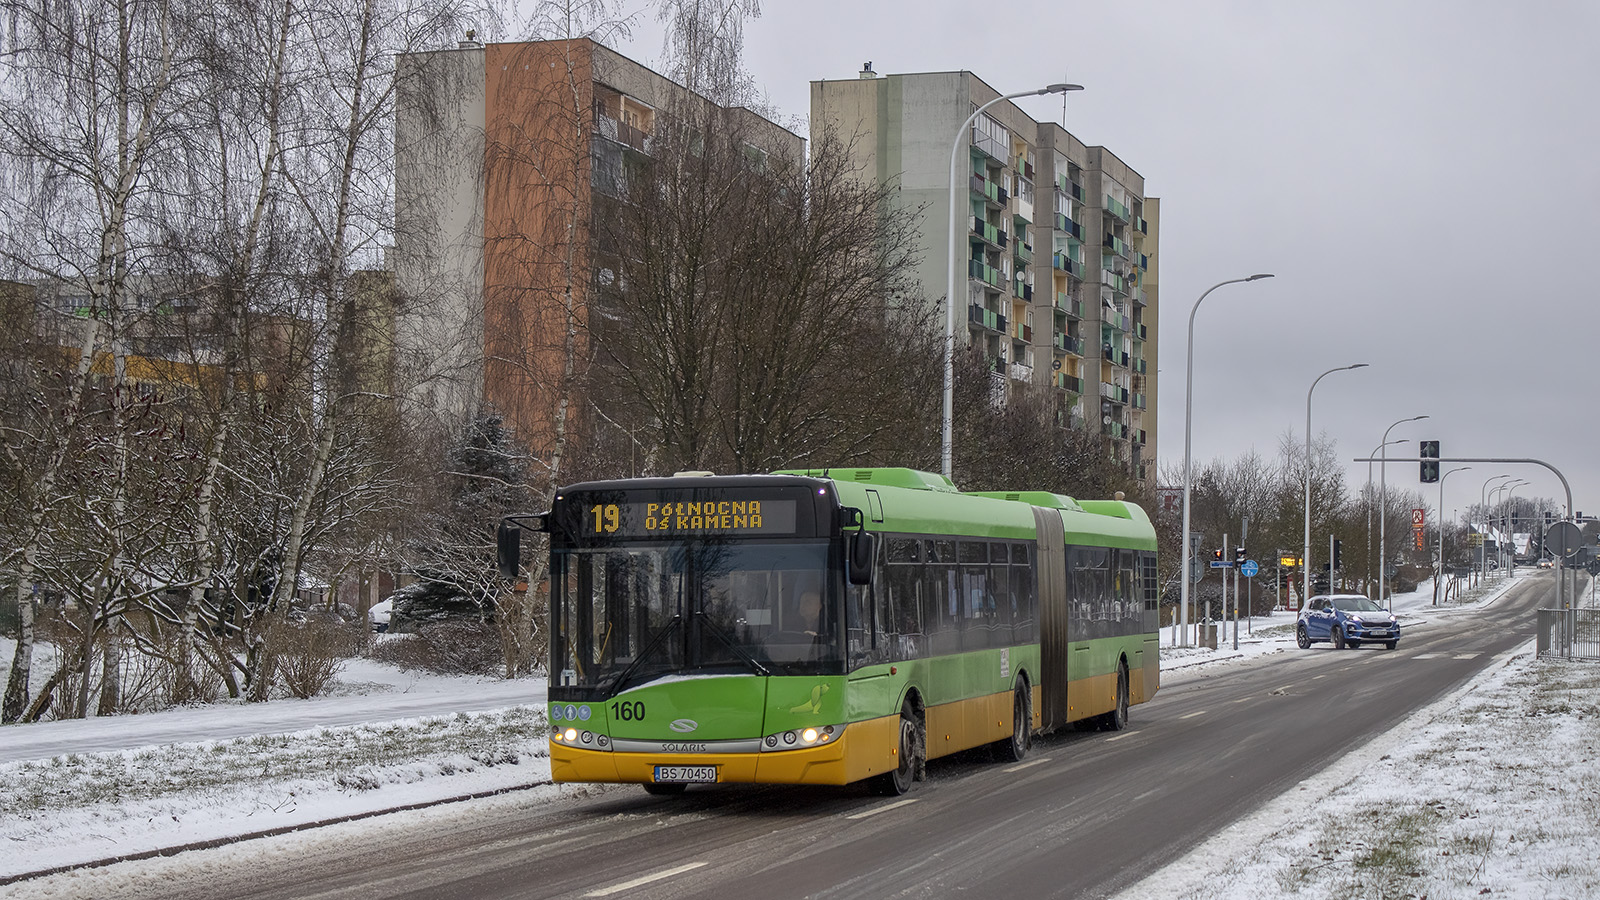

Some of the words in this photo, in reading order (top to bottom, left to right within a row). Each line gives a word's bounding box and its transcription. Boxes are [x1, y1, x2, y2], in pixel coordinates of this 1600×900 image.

[591, 504, 620, 533] 19
[676, 514, 762, 530] KAMENA
[611, 701, 646, 721] 160
[661, 743, 707, 752] SOLARIS
[661, 768, 677, 779] BS
[680, 768, 714, 779] 70450
